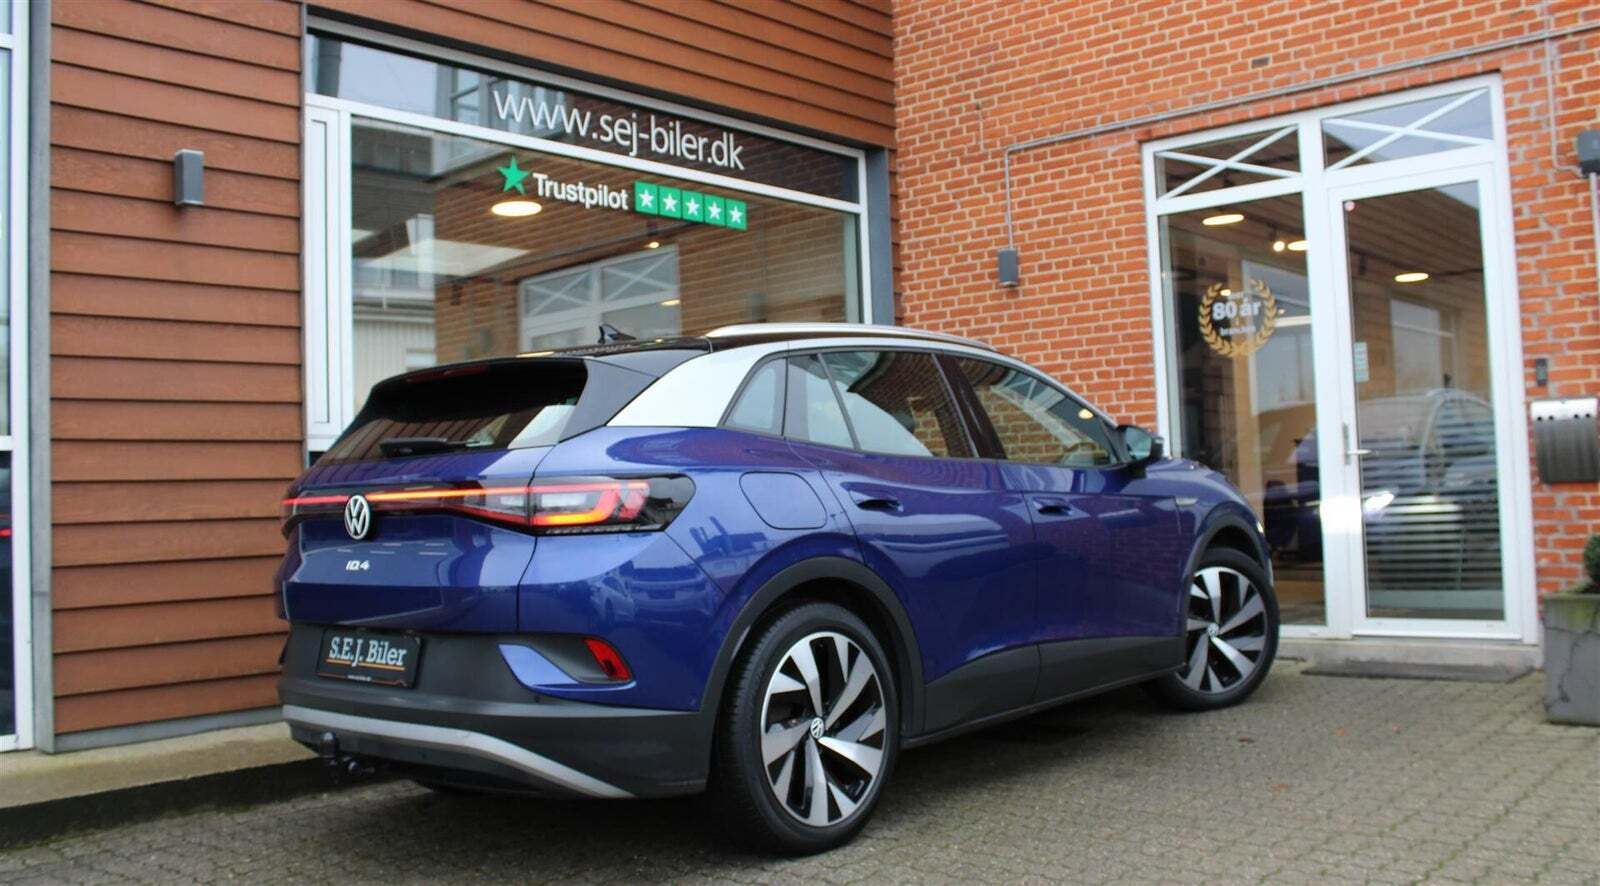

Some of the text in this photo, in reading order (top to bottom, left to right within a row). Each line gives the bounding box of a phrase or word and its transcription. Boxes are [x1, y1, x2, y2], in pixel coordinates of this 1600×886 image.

[493, 90, 745, 170] www.sej-biler.dk
[532, 172, 629, 210] Trustpilot
[1212, 301, 1237, 321] 80
[328, 636, 407, 667] S.E.J. Biler
